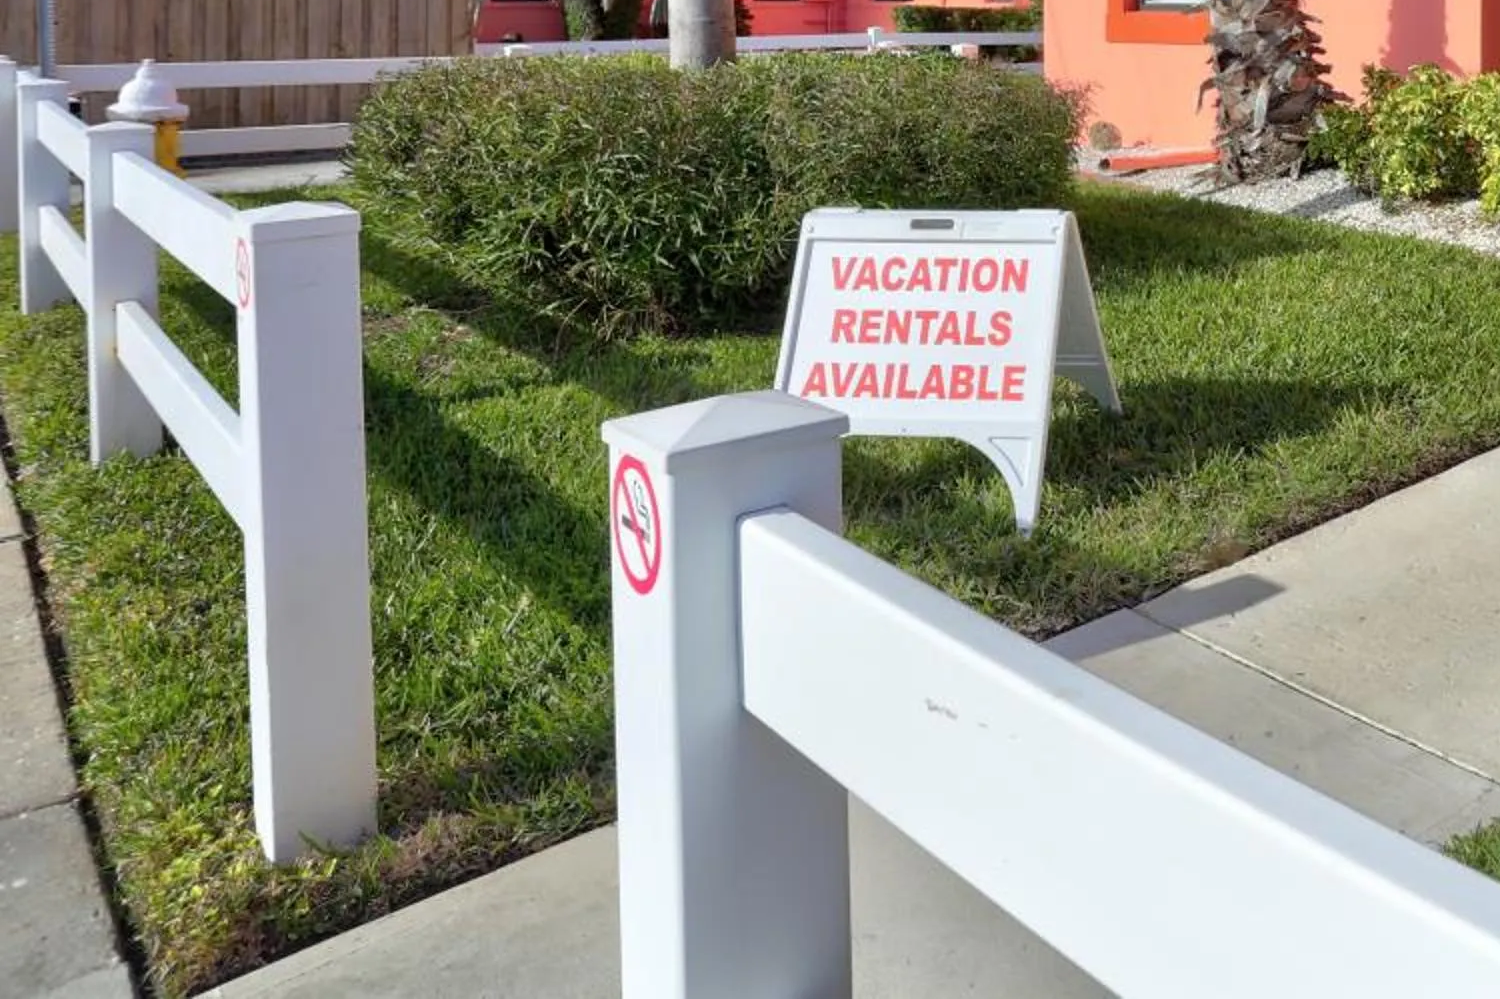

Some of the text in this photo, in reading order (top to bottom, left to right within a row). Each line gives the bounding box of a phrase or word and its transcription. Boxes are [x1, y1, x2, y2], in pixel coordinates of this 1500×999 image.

[831, 256, 1029, 293] VACATION
[831, 309, 1013, 346] RENTALS
[800, 362, 1027, 401] AVAILABLE
